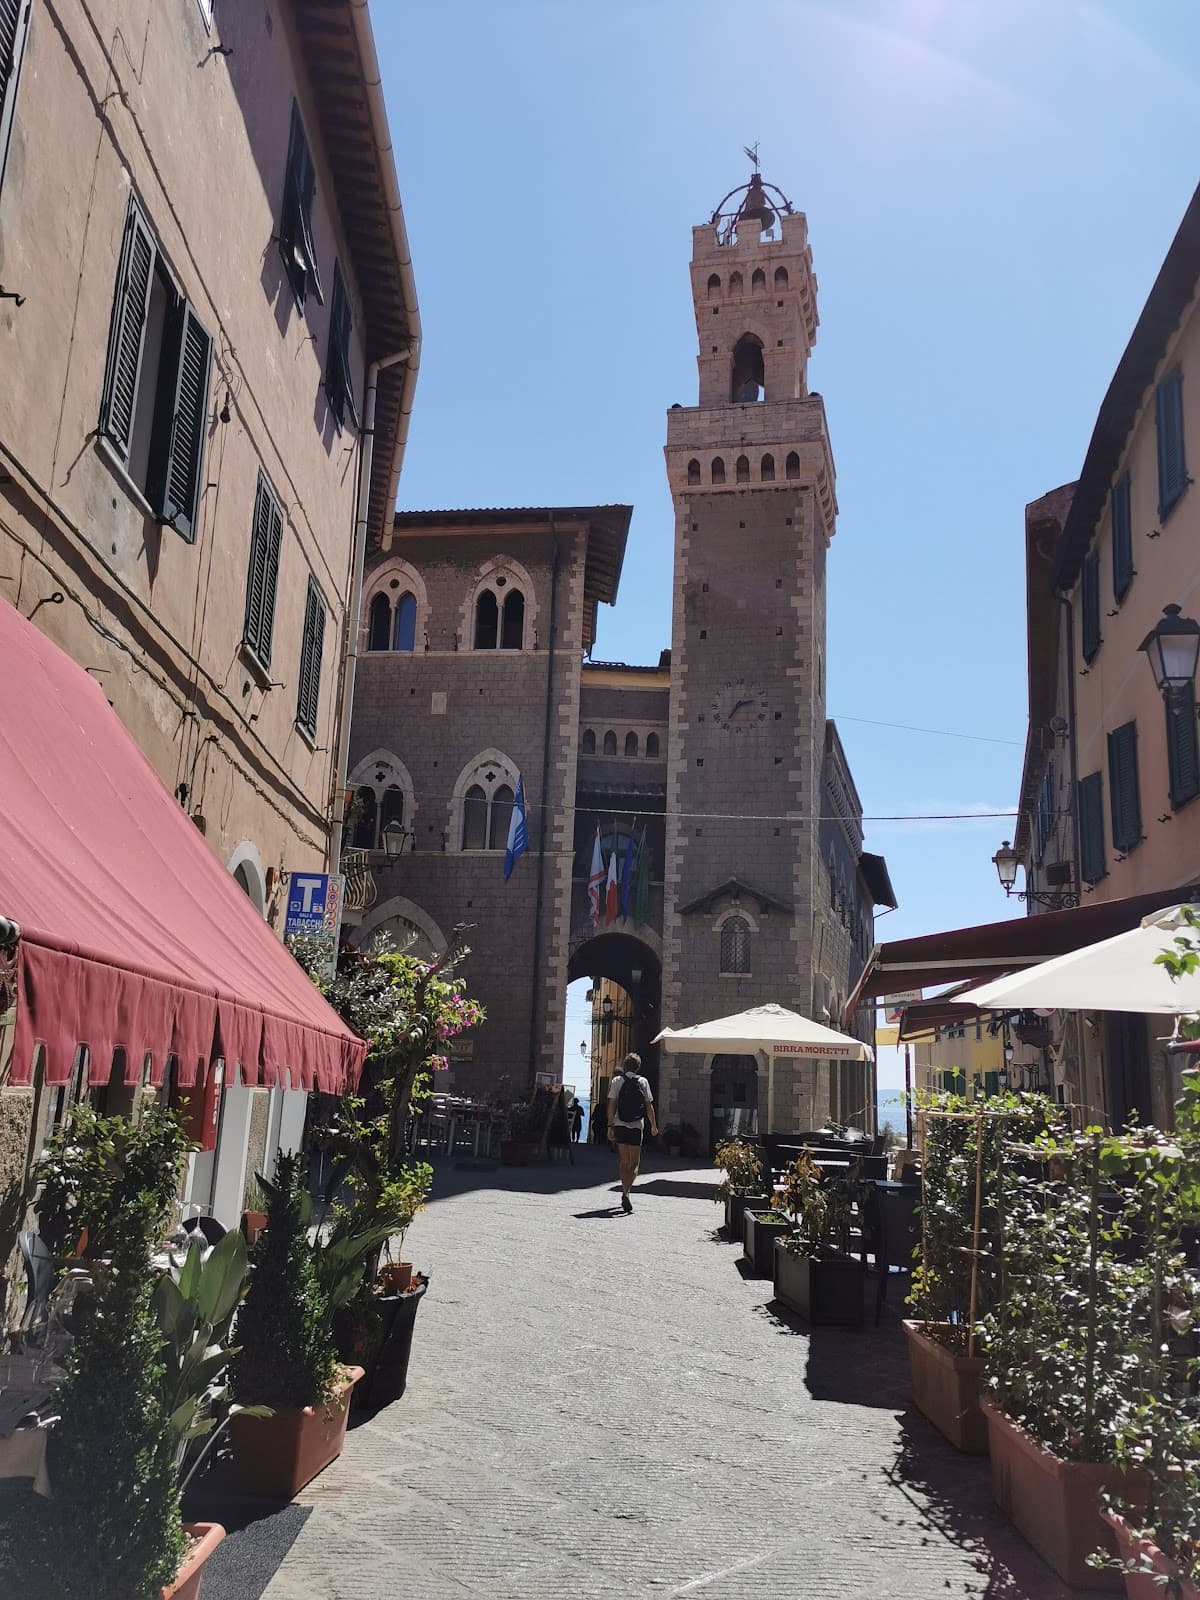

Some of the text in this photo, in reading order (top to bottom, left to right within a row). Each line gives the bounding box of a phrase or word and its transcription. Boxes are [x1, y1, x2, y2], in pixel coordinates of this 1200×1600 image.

[297, 879, 322, 913] T
[288, 918, 323, 928] TABACCHI
[773, 1045, 849, 1055] BIRRA MORETTI
